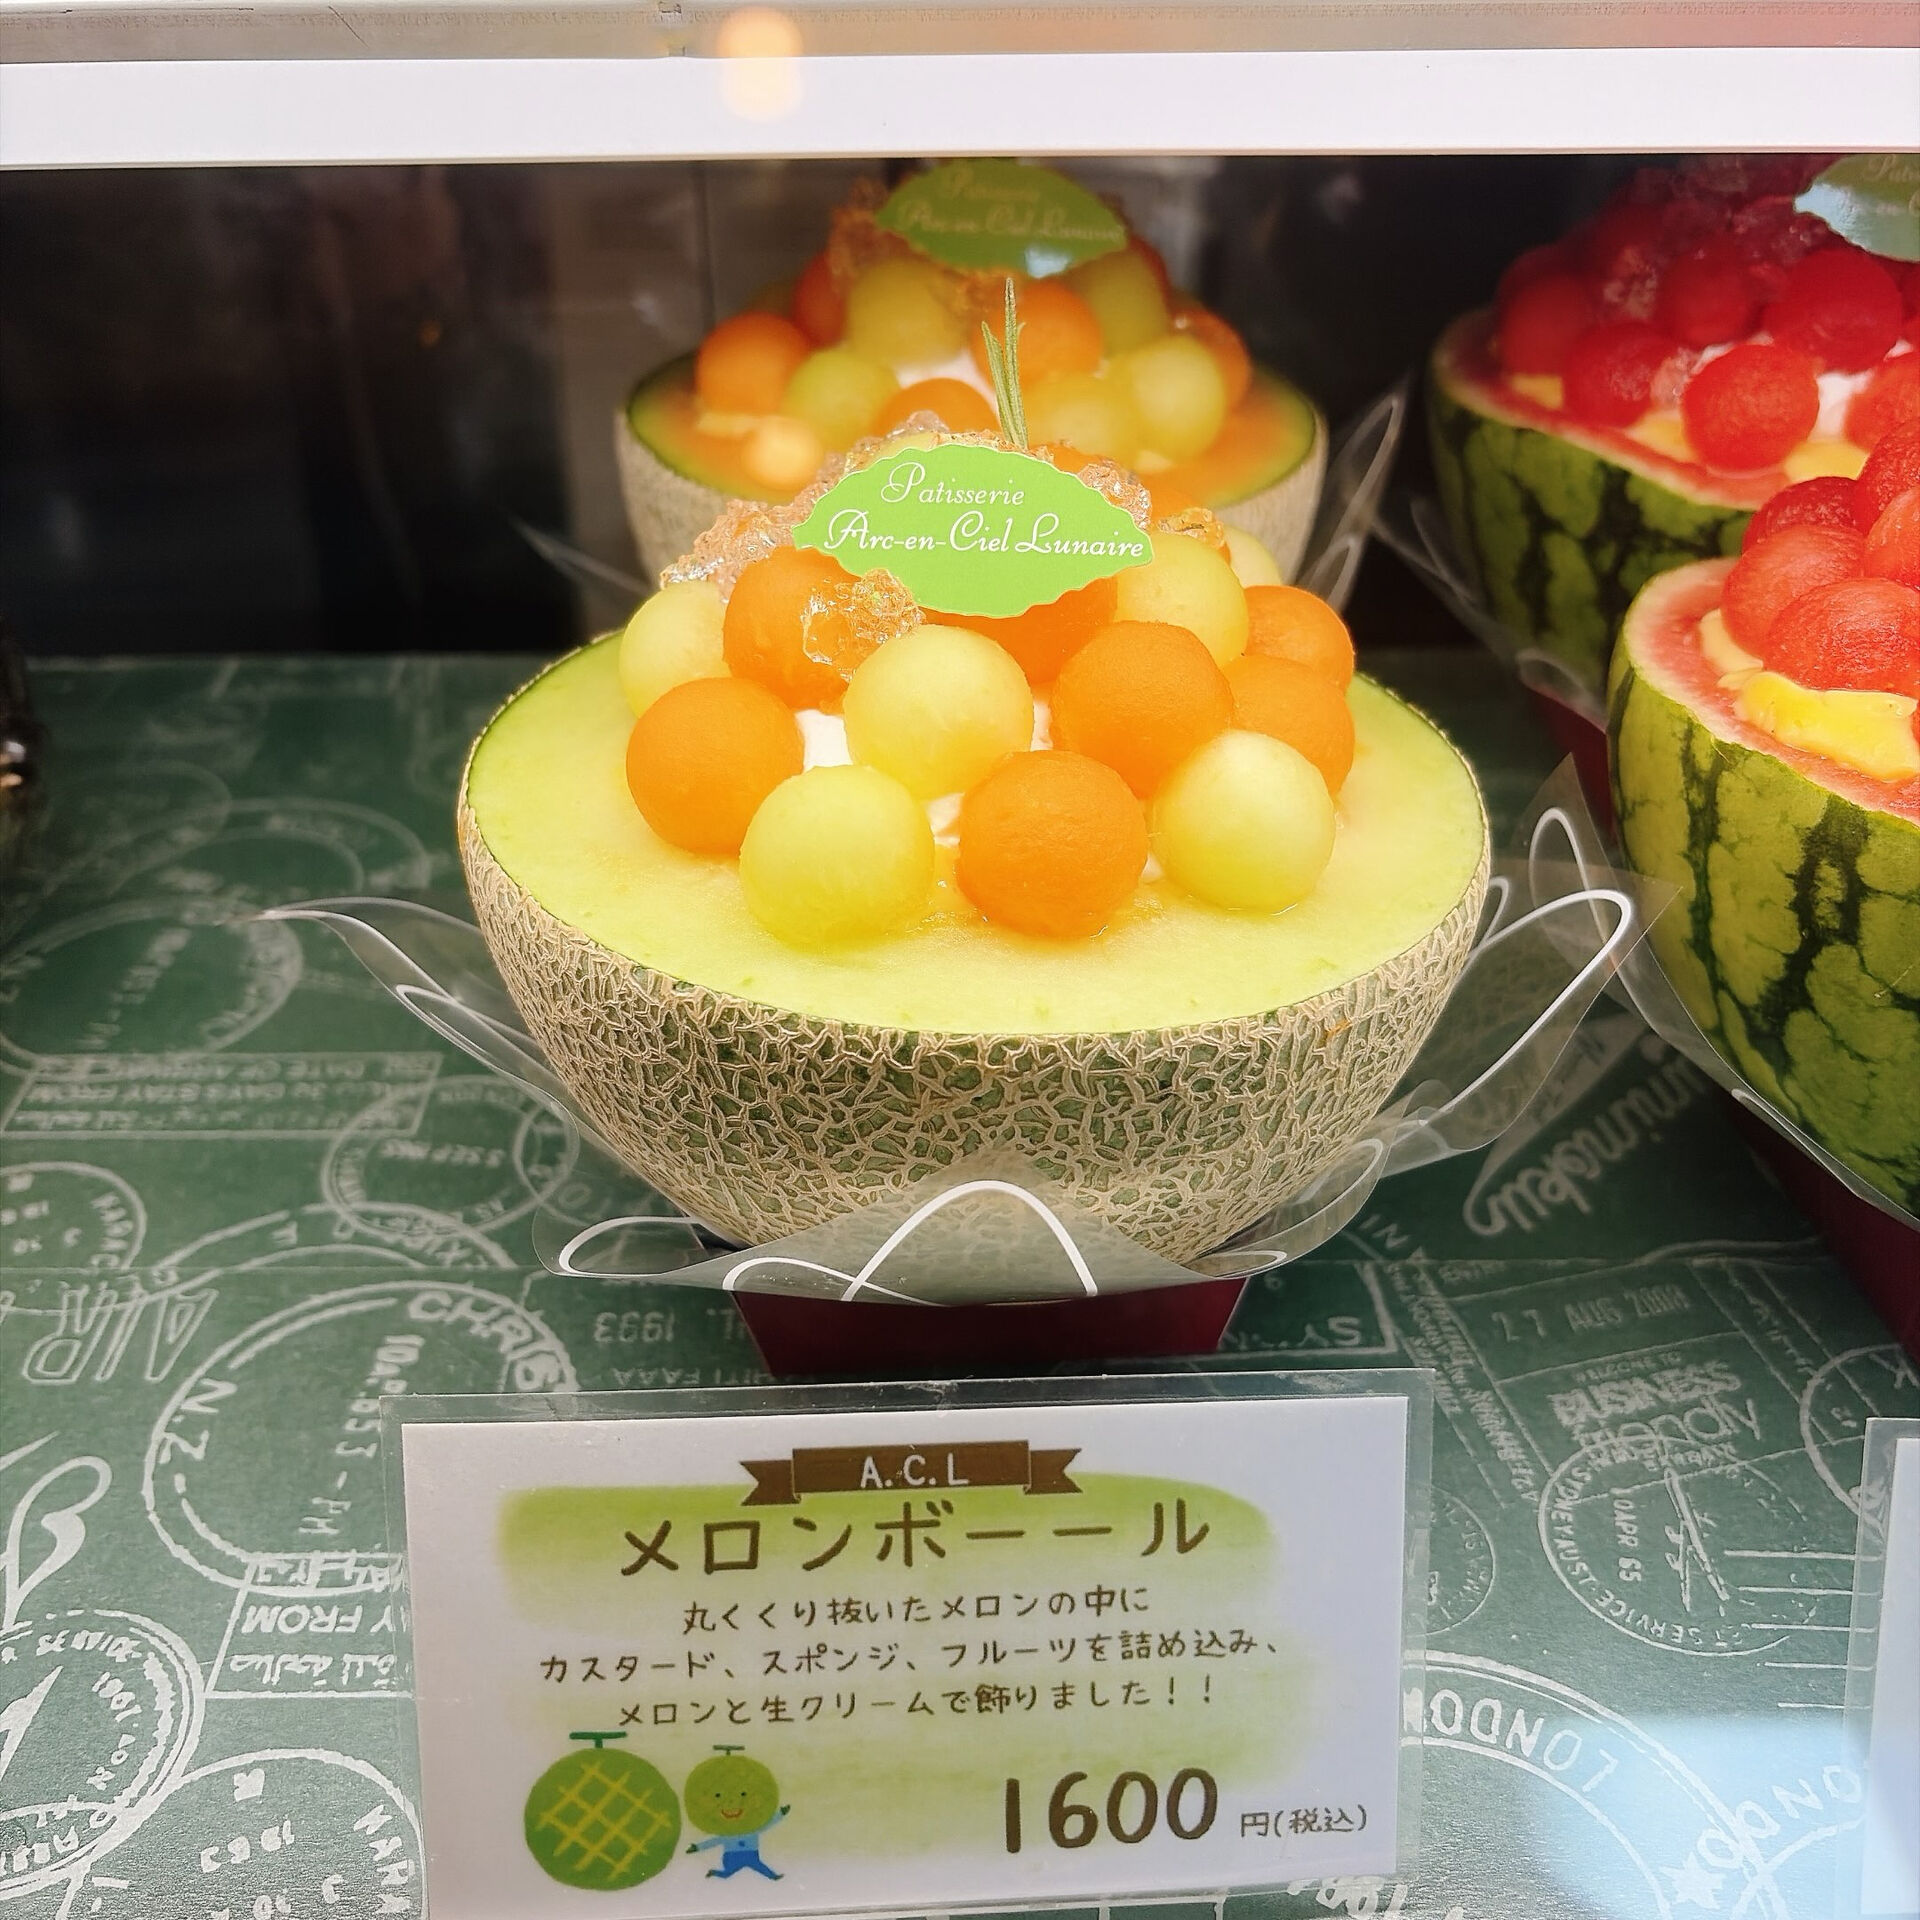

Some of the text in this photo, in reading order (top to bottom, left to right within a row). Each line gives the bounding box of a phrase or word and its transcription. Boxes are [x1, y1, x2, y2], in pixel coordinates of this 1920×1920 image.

[881, 461, 1025, 505] Patisserie
[823, 509, 1144, 558] Arc-en-Ciel Lunaire
[593, 1310, 675, 1343] 1993
[859, 1453, 970, 1489] A.C.L
[620, 1497, 1211, 1576] メロンボーール
[240, 1604, 364, 1635] FROM
[682, 1584, 1150, 1635] 丸くくり抜いたメロンの中に
[1005, 1767, 1219, 1854] 1600
